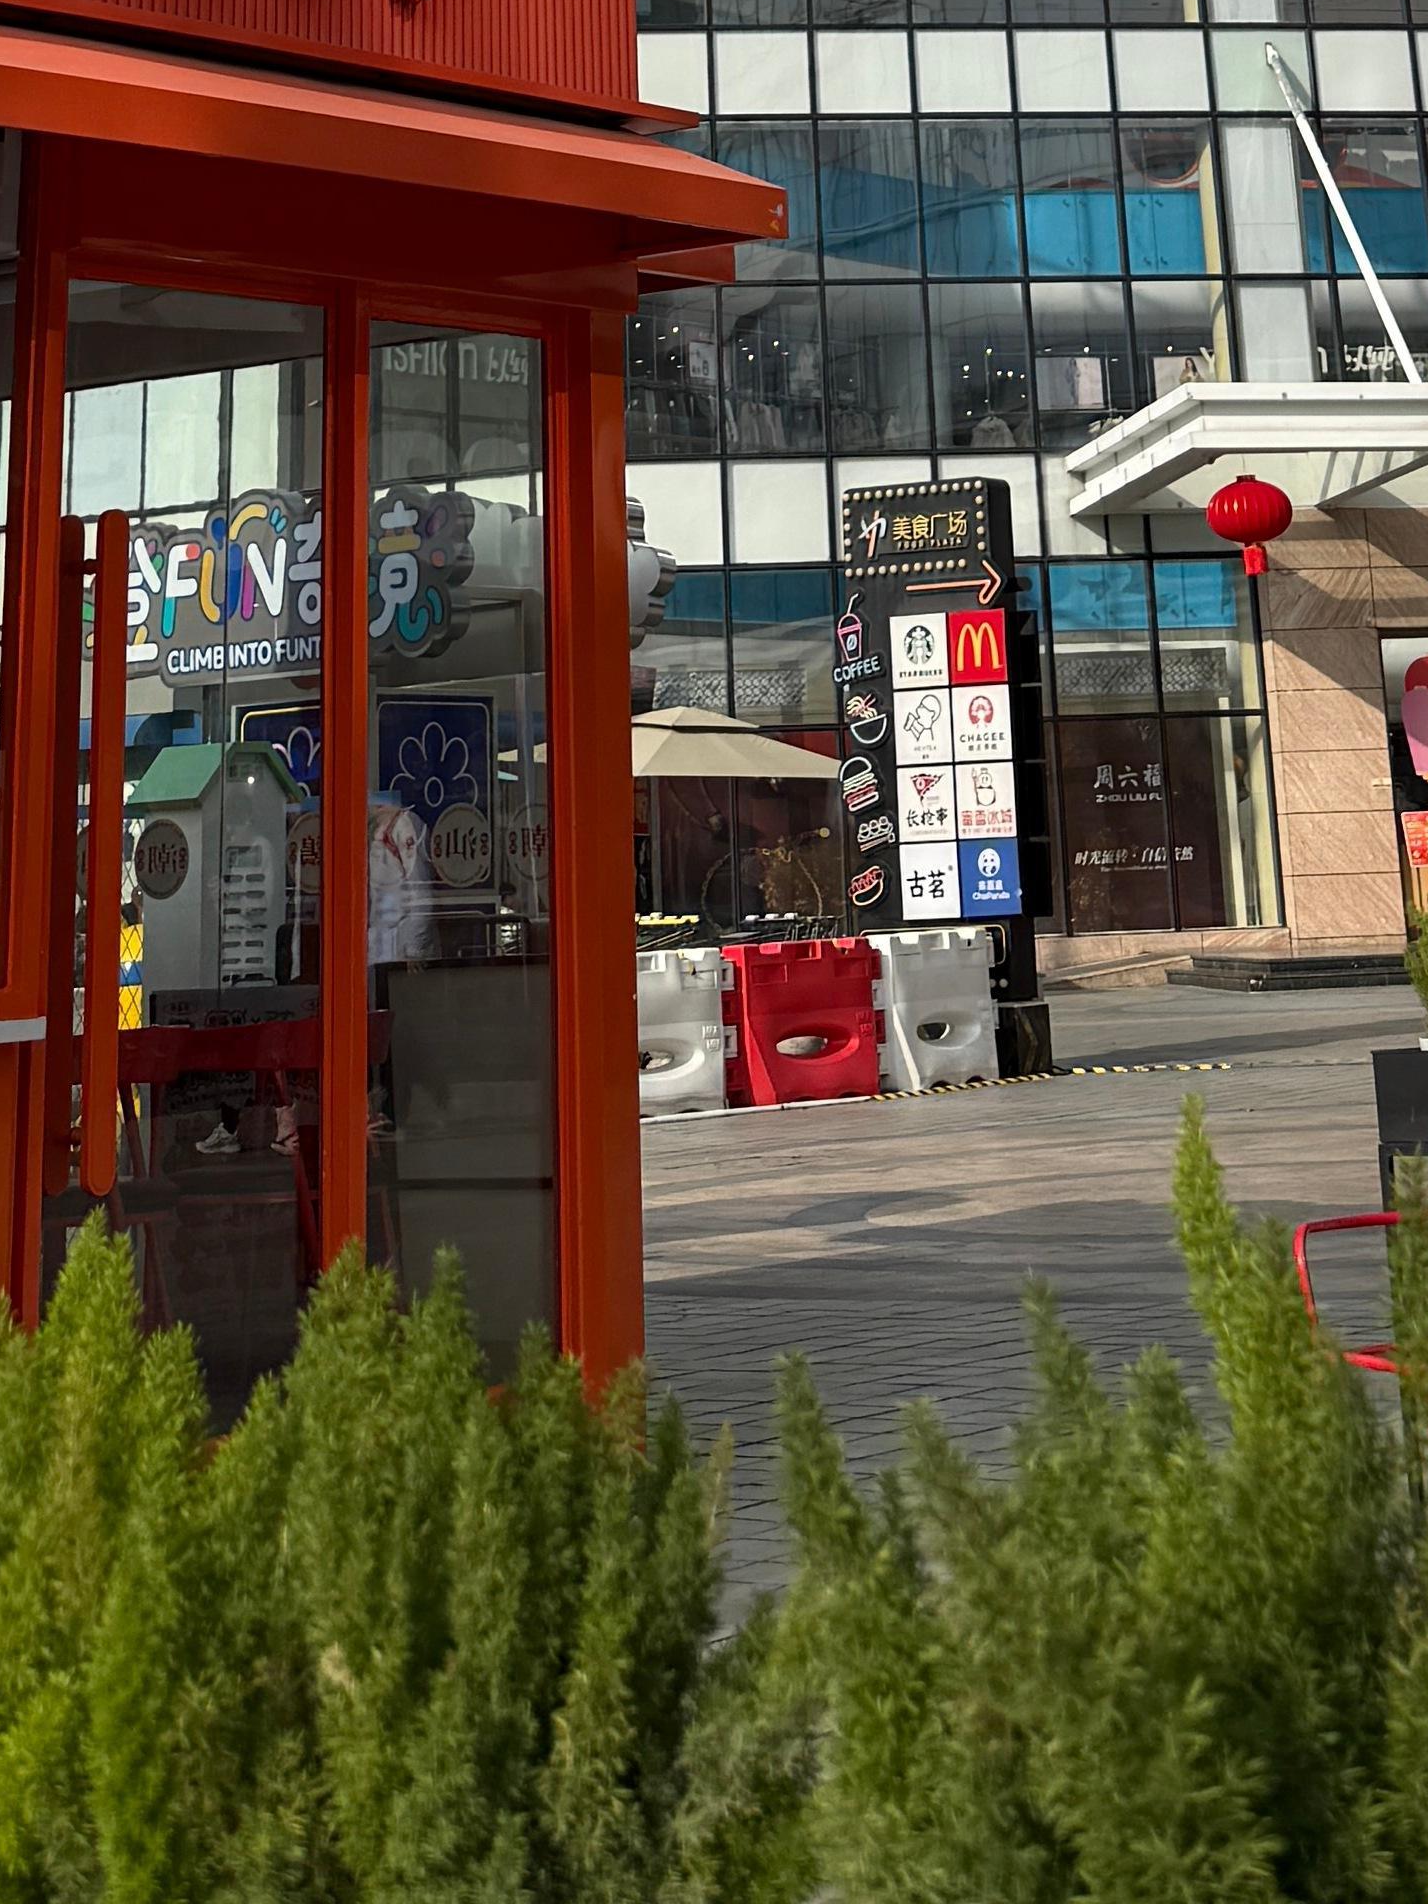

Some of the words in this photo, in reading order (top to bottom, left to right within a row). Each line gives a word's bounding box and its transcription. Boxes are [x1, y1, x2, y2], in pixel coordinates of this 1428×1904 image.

[892, 510, 968, 542] 美食广场
[167, 644, 225, 674] CLIMB
[228, 640, 270, 668] INTO
[833, 655, 881, 683] COFFEE
[959, 732, 1005, 743] CHAGEE
[1093, 763, 1162, 790] 周六福
[906, 869, 945, 899] 古茗
